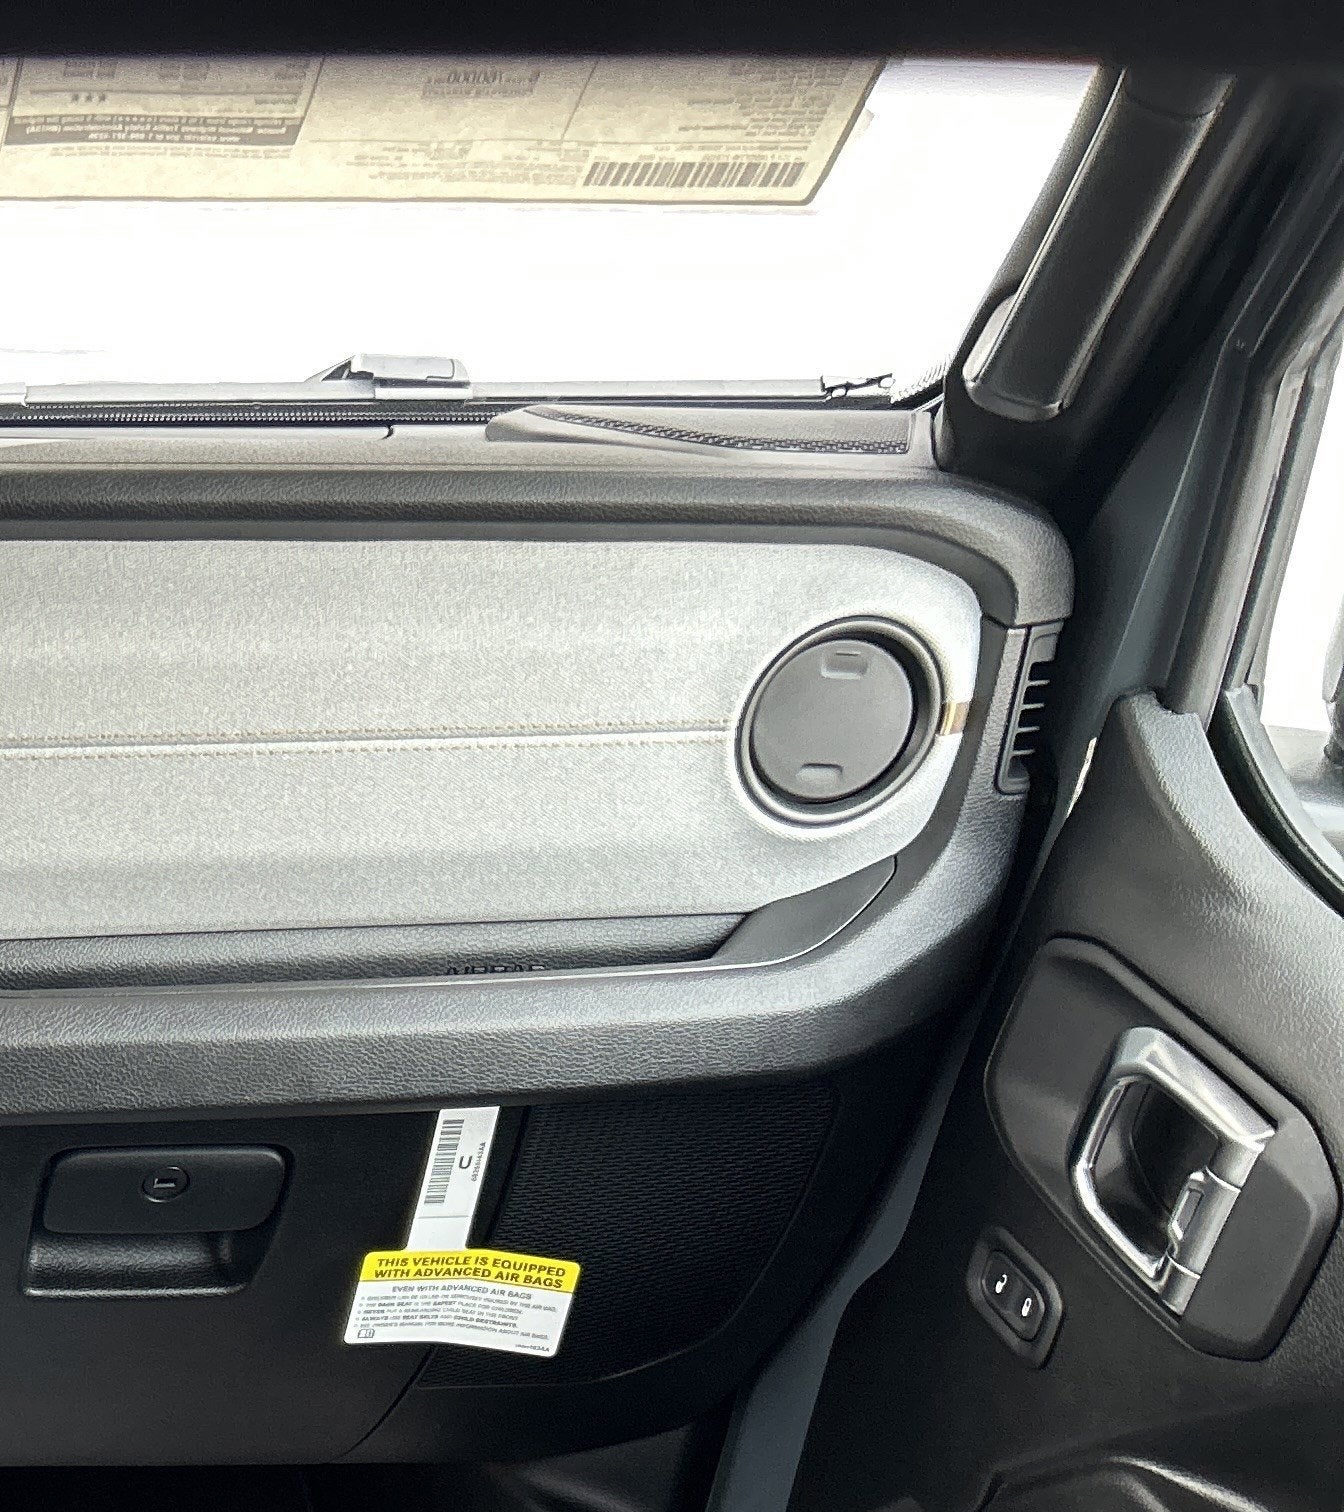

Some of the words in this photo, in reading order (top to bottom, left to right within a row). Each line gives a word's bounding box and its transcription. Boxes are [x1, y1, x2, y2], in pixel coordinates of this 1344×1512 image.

[459, 1155, 472, 1169] U
[377, 1257, 409, 1267] THIS
[412, 1256, 470, 1267] VEHICLE
[474, 1256, 489, 1266] IS
[491, 1258, 566, 1278] EQUIPPED
[374, 1268, 410, 1279] WITH
[414, 1267, 492, 1278] ADVANCED
[495, 1270, 520, 1282] AIR
[523, 1274, 564, 1289] BAGS
[441, 1284, 488, 1294] ADVANCED
[490, 1288, 506, 1296] AIR
[507, 1290, 532, 1300] BAGS
